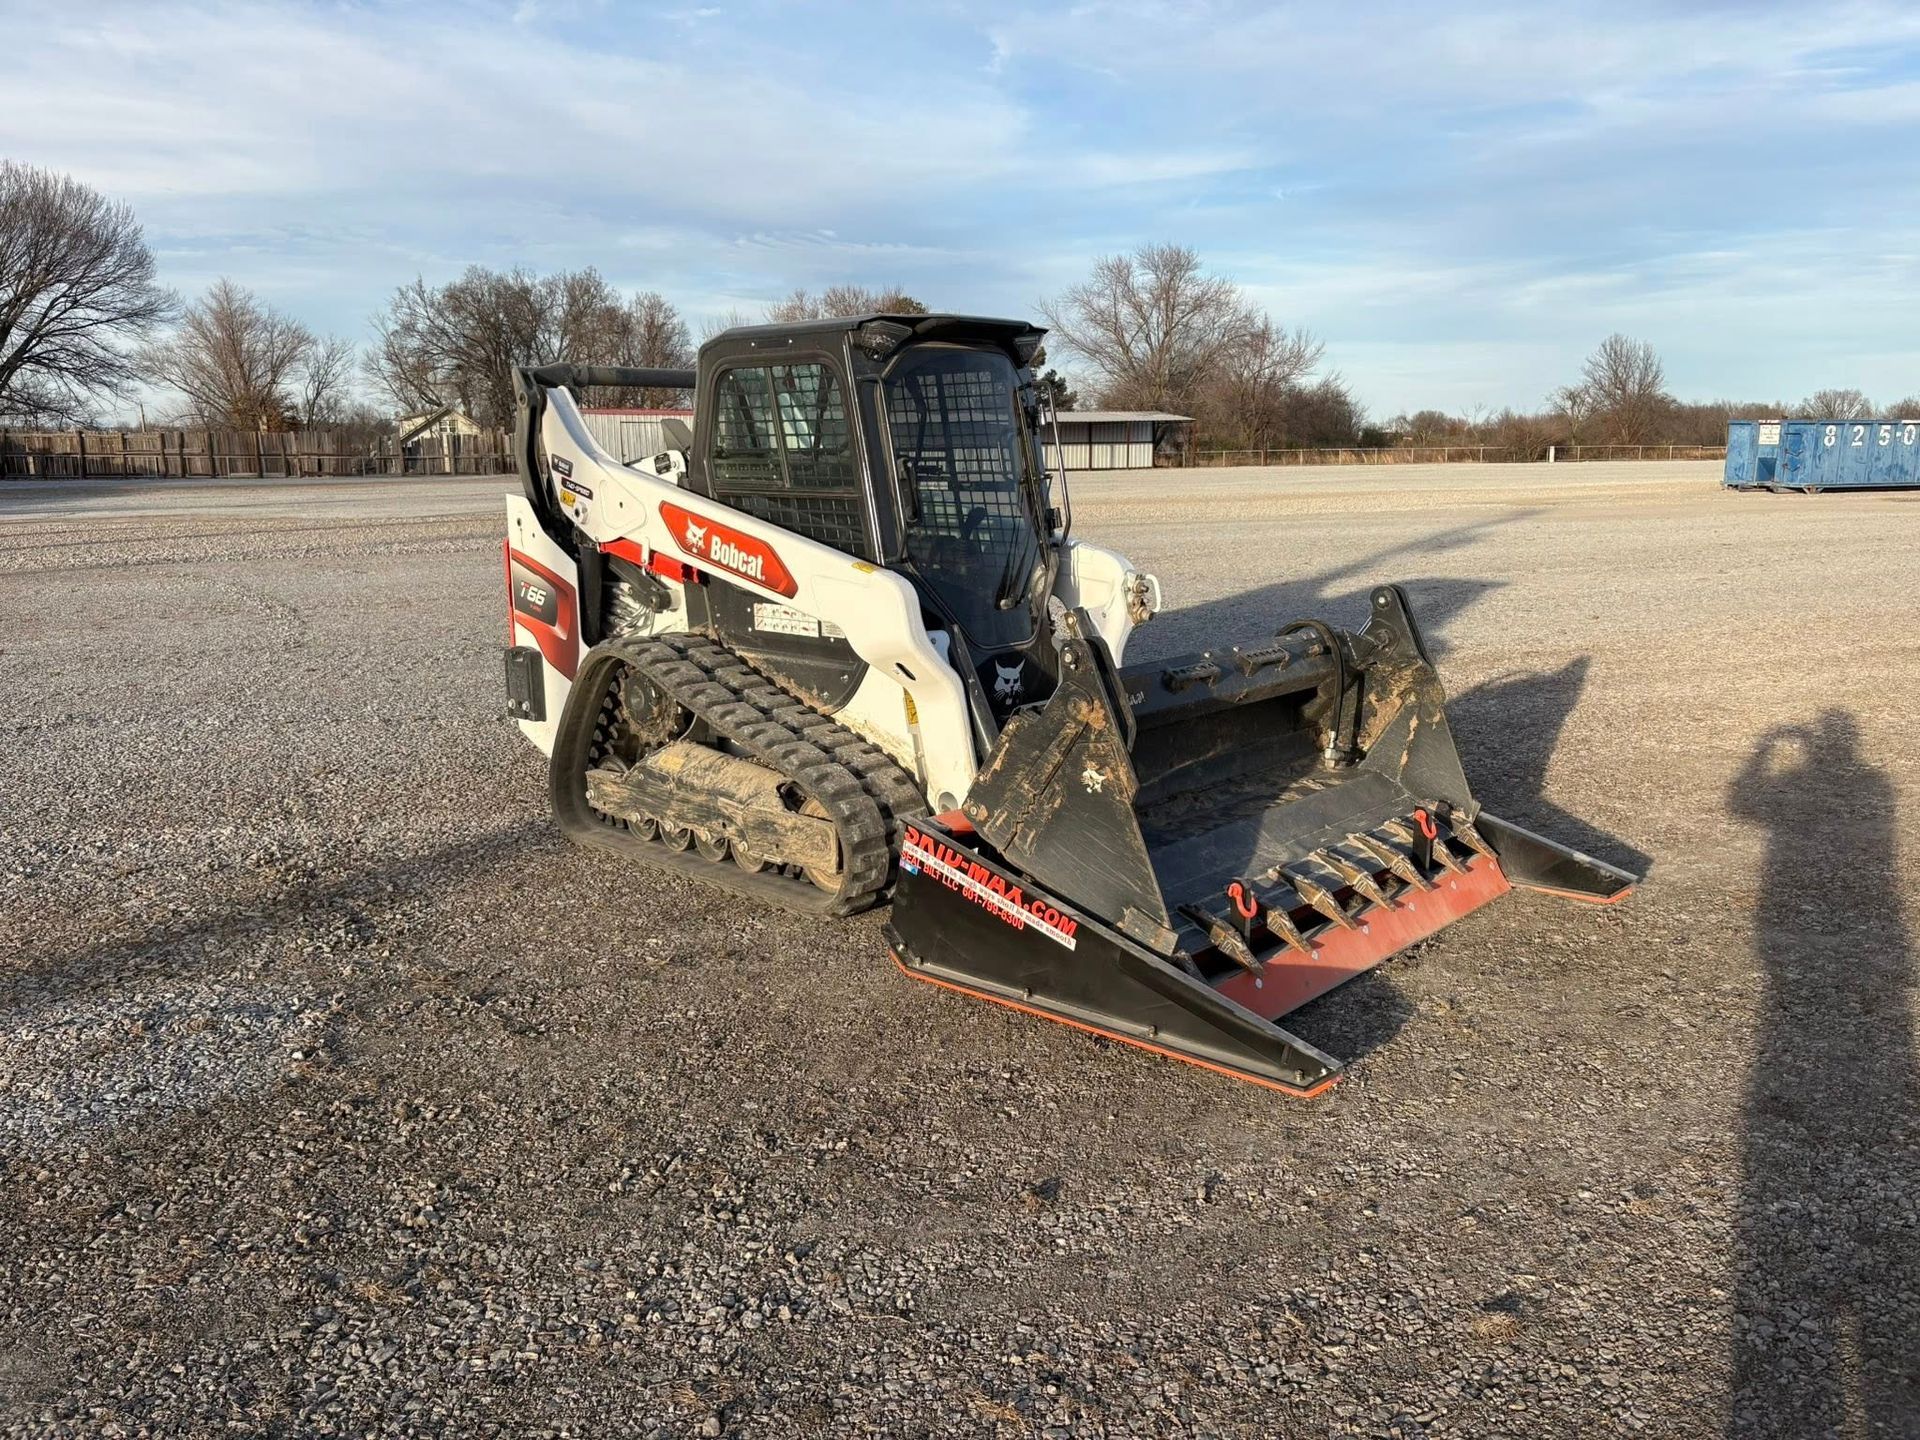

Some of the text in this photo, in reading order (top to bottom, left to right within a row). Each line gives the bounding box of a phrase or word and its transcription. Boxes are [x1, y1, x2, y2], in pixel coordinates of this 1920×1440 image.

[710, 535, 764, 580] Bobcat
[520, 581, 547, 606] T66
[901, 850, 922, 870] SEAL
[942, 873, 959, 891] LLC
[947, 866, 957, 879] the
[958, 873, 978, 892] rough
[979, 888, 995, 901] ways
[997, 896, 1015, 911] shall
[1015, 905, 1025, 917] be
[1025, 913, 1044, 929] made
